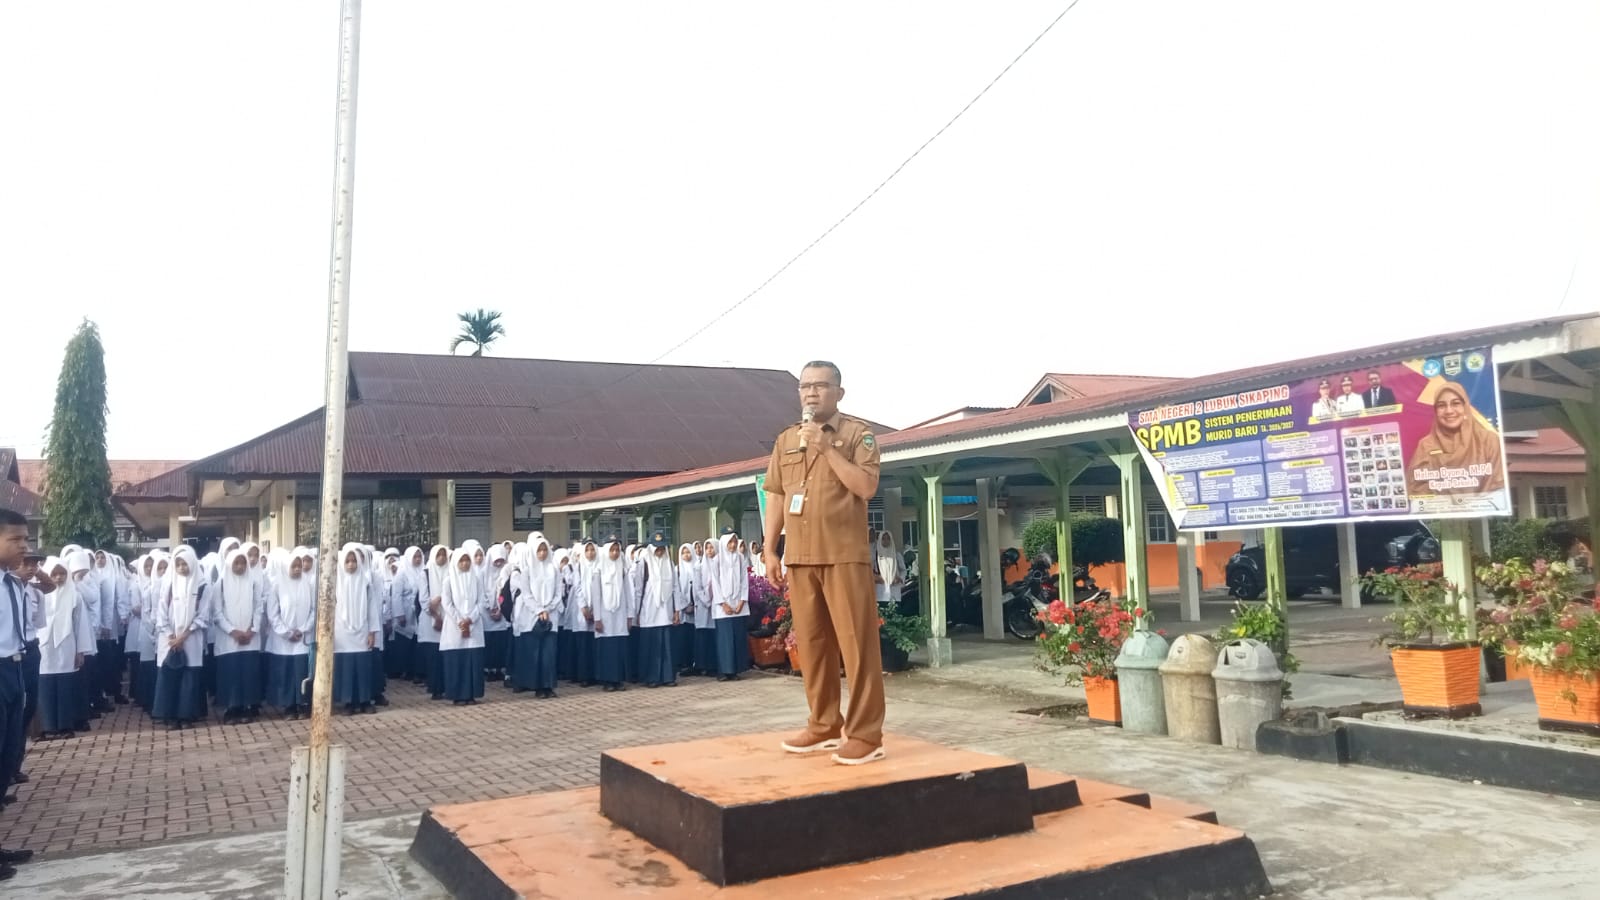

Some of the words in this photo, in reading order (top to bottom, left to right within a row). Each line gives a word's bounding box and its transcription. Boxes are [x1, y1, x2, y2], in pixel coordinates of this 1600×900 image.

[1139, 410, 1159, 424] SMA
[1160, 402, 1194, 421] NEGERI
[1195, 401, 1203, 415] 2
[1204, 394, 1238, 413] LUBUK
[1238, 385, 1290, 407] SIKAPING
[1205, 414, 1234, 428] SISTEM
[1236, 405, 1292, 423] PENERIMAAN
[1136, 419, 1202, 450] SPMB
[1206, 428, 1233, 442] MURID
[1235, 425, 1258, 438] BARU
